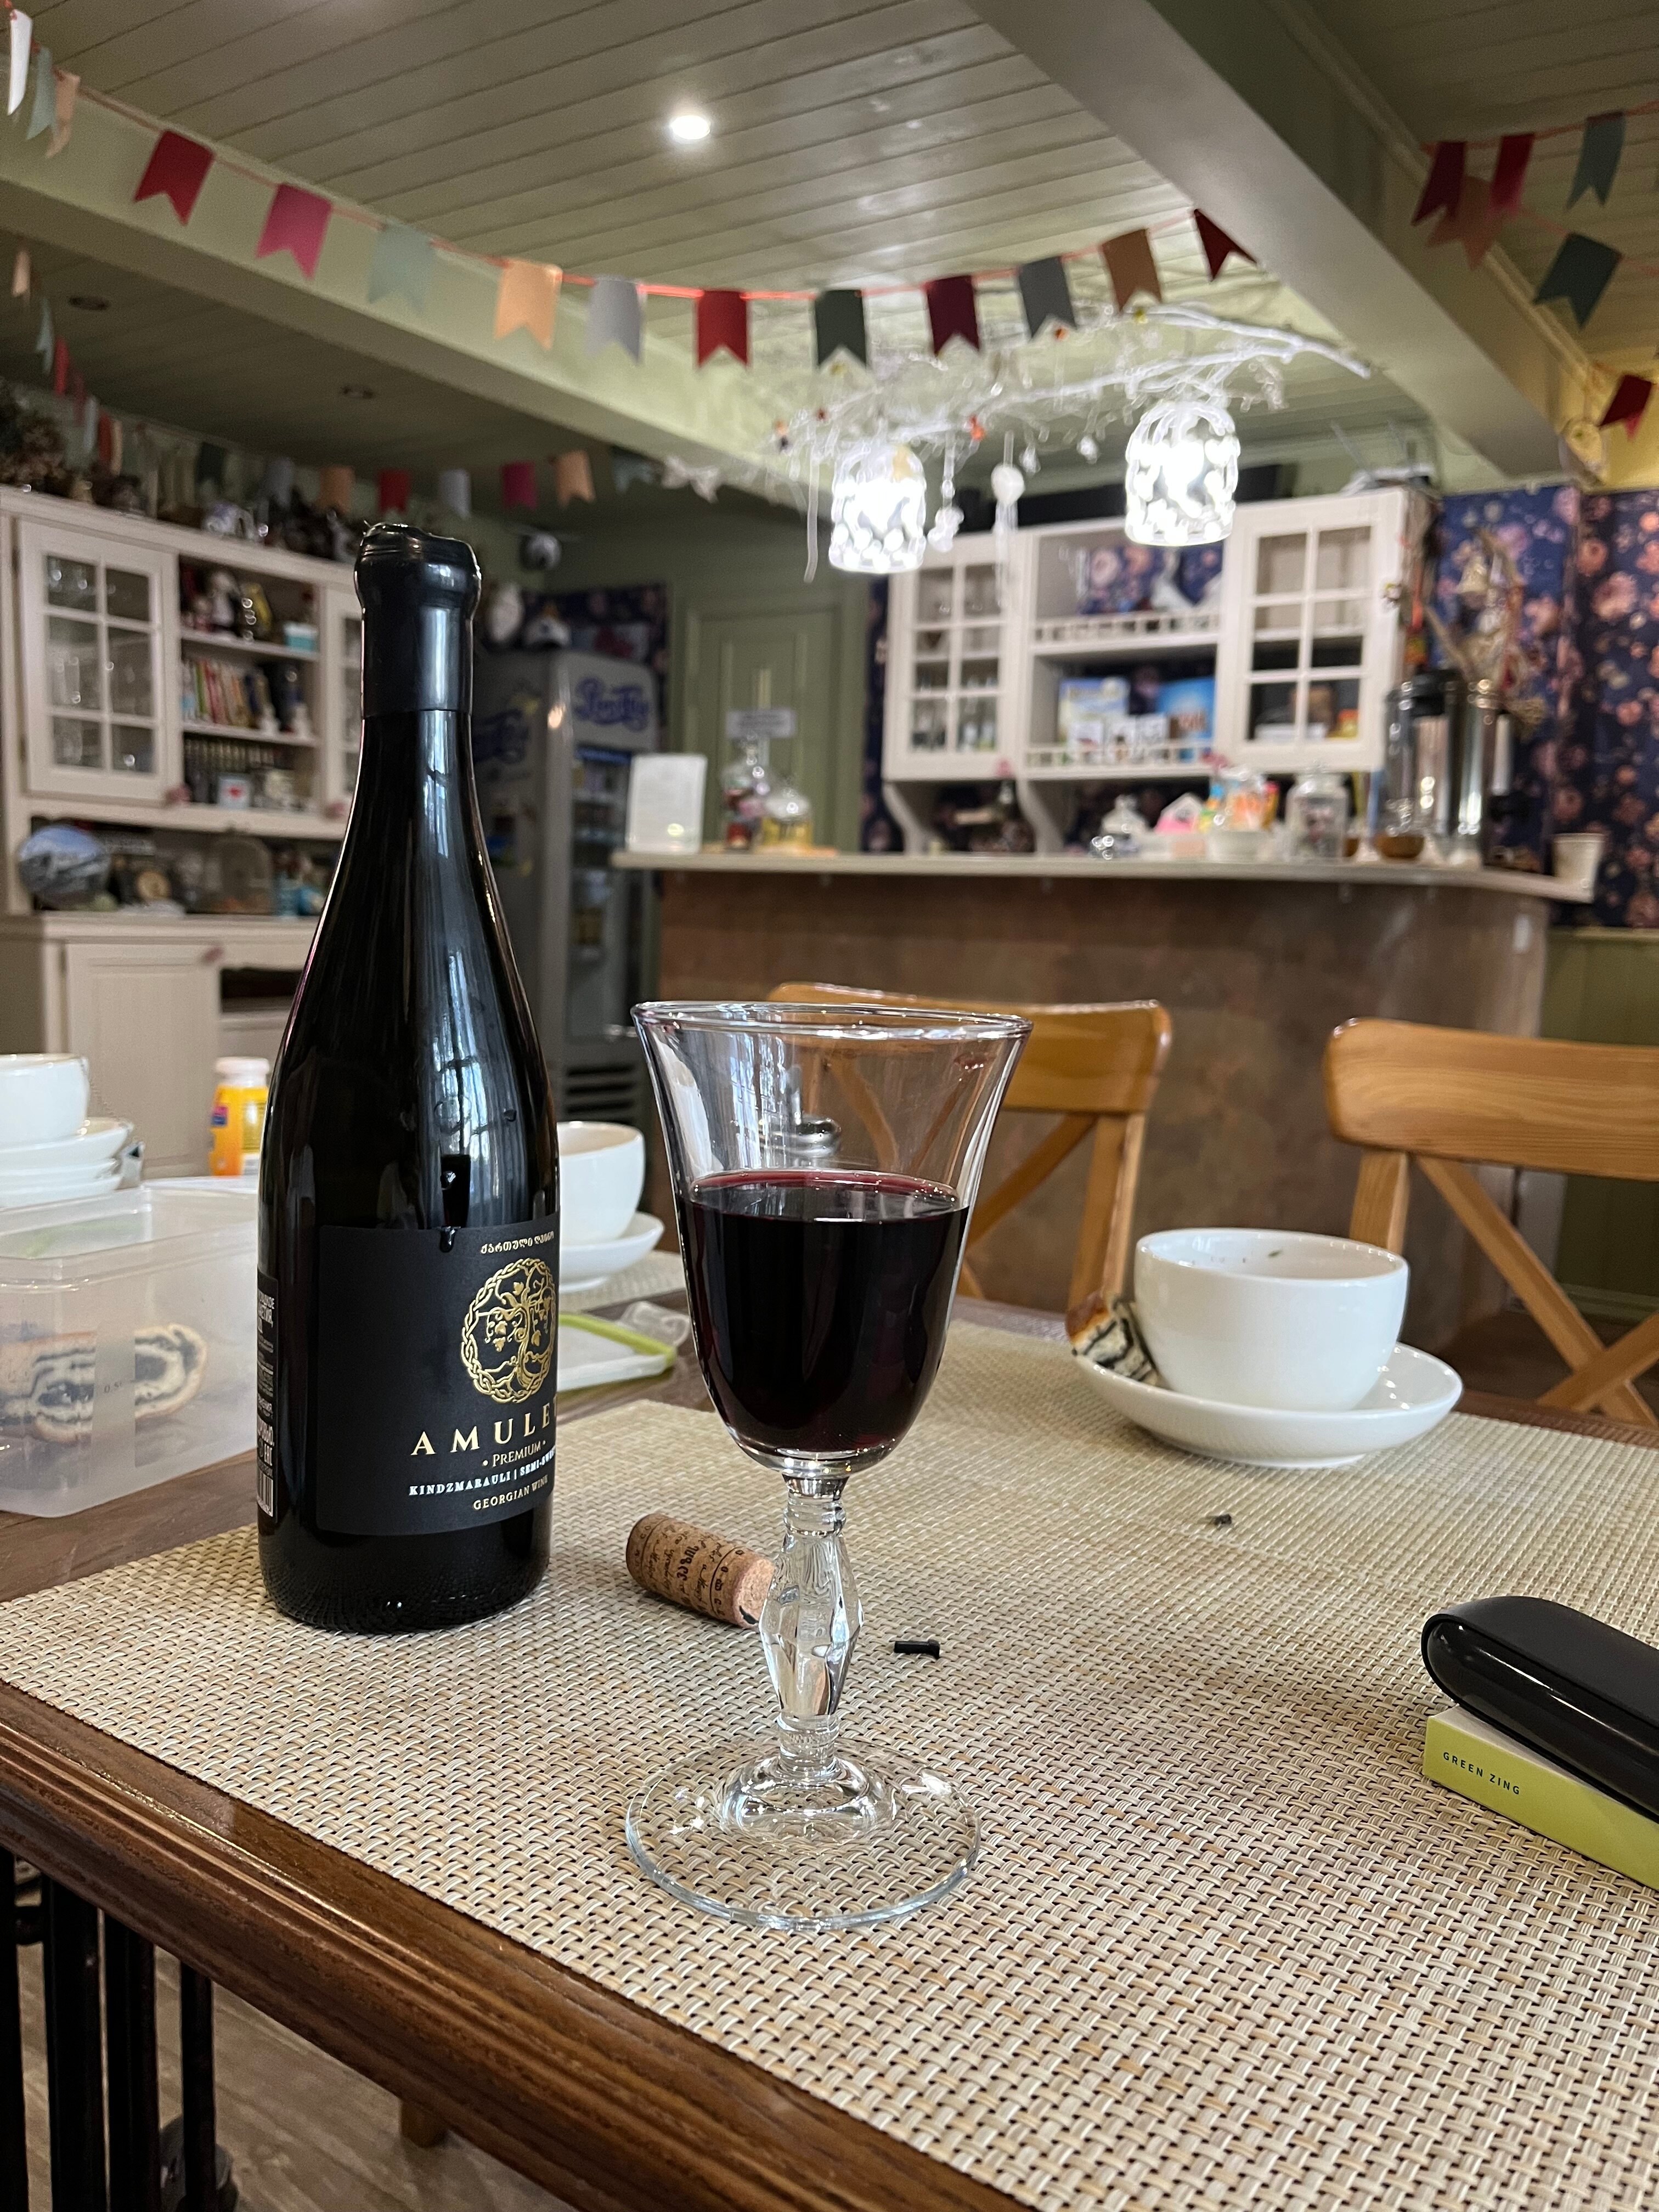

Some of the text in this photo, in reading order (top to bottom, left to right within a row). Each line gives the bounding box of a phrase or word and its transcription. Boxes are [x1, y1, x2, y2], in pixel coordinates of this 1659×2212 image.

[481, 1237, 533, 1254] ქართული
[492, 1441, 541, 1462] PREMIUM
[409, 1471, 511, 1497] KINDZMARAULI
[473, 1474, 548, 1510] GEORGIAN WINE
[1443, 1752, 1520, 1795] GREEN ZING
